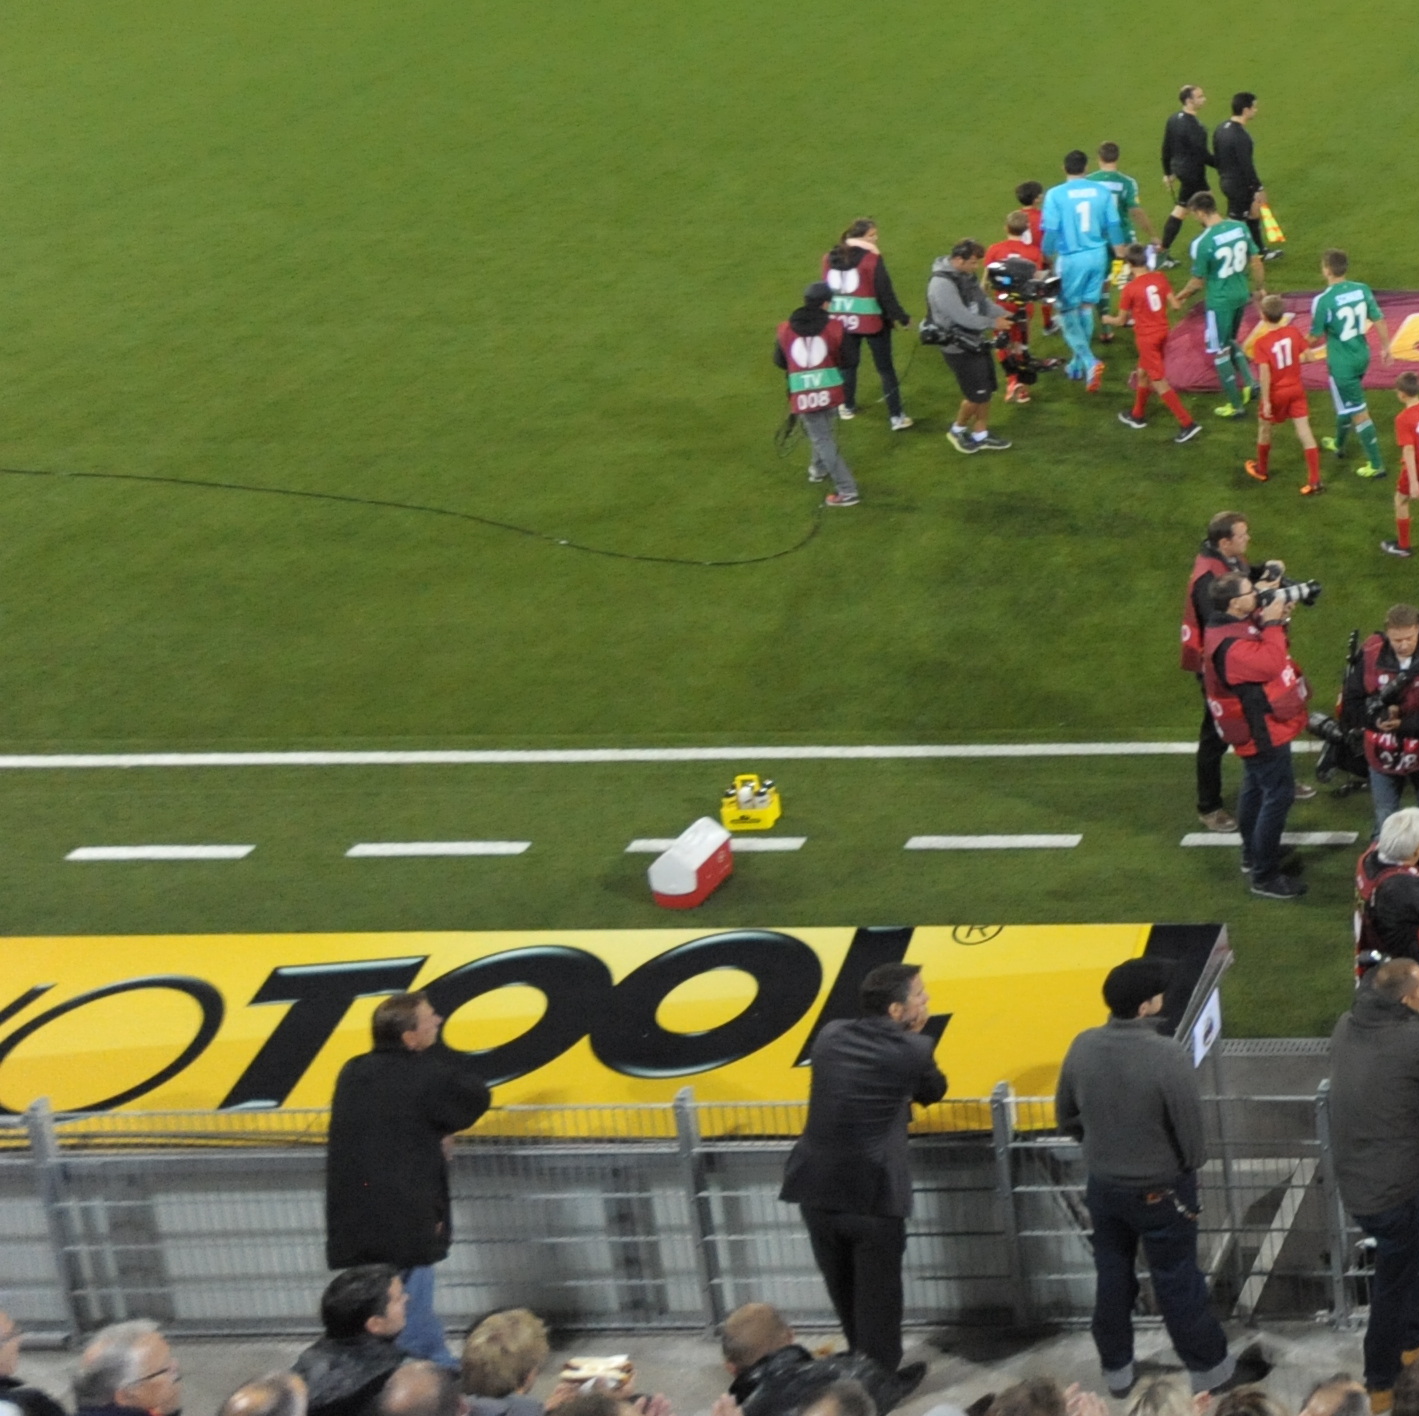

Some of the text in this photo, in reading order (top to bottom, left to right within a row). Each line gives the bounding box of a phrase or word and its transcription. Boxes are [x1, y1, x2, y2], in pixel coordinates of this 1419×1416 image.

[1075, 201, 1090, 233] 1
[1214, 240, 1248, 278] 28
[834, 297, 855, 312] TV
[1146, 284, 1162, 312] 6
[1336, 301, 1367, 341] 21
[1271, 337, 1292, 370] 17
[801, 373, 823, 389] TV
[797, 391, 831, 411] 008
